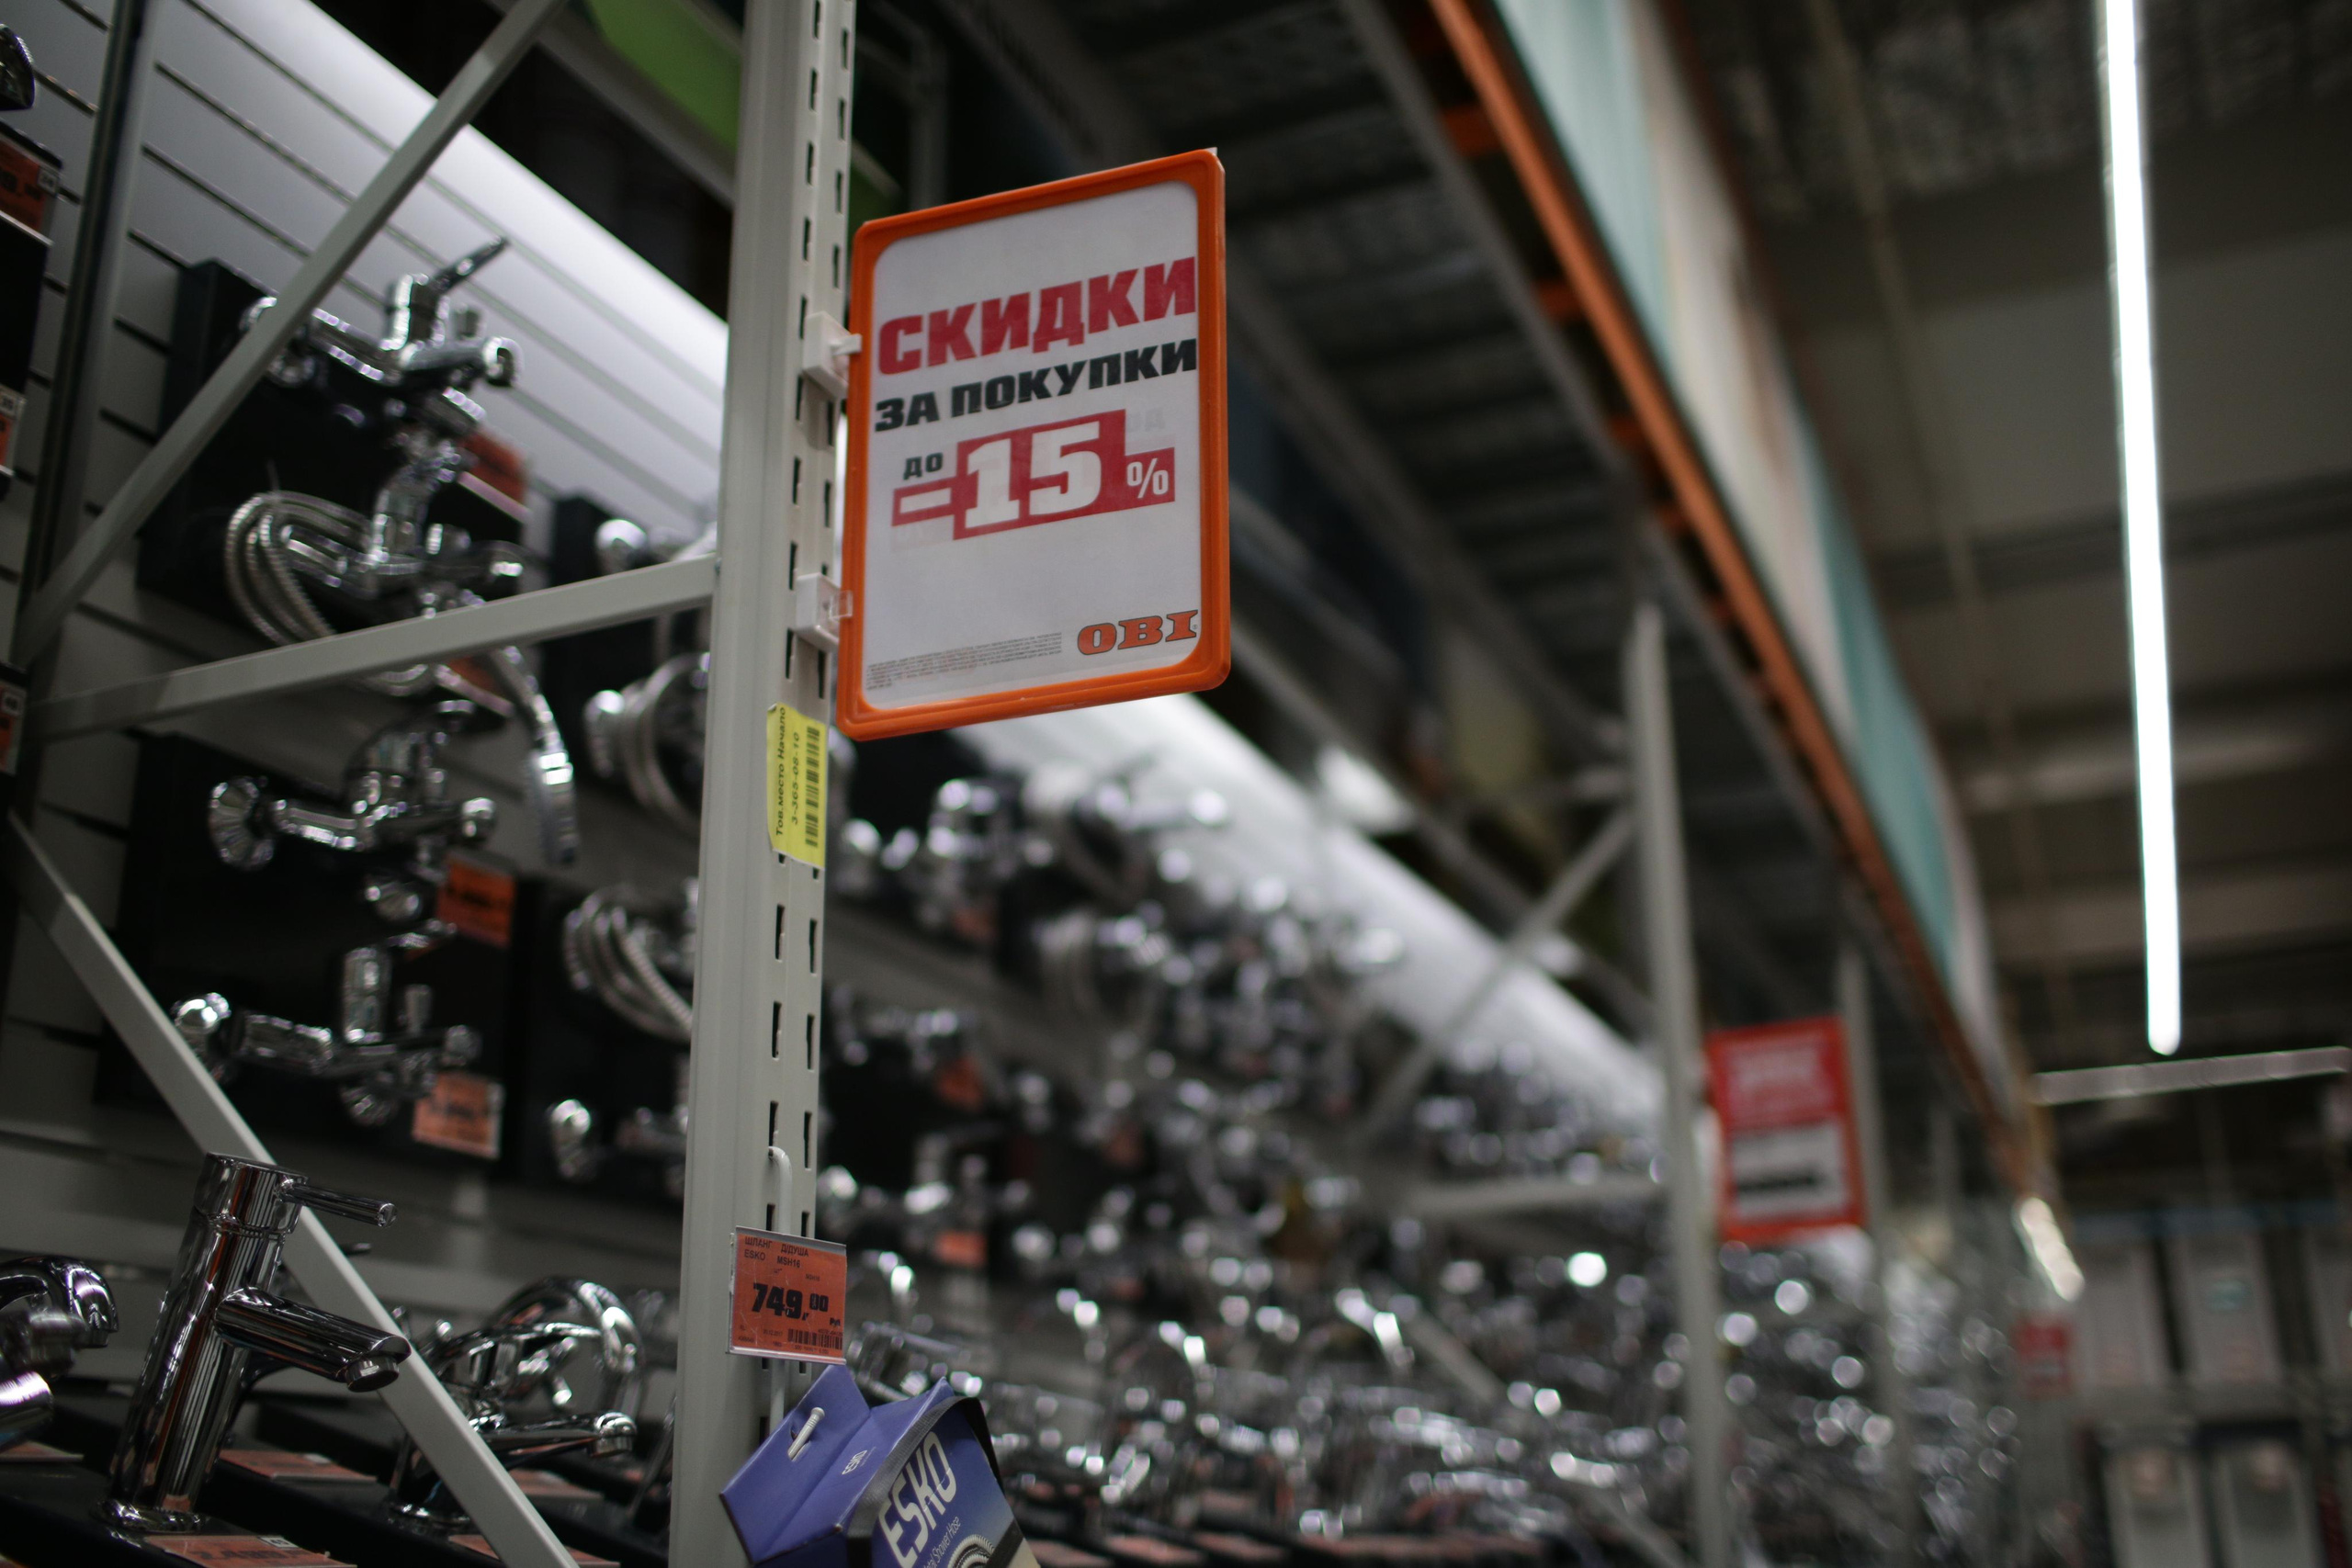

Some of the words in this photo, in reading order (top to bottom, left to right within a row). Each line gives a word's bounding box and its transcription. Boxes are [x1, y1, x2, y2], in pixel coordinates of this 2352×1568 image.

[878, 256, 1196, 376] СКИДКИ
[875, 392, 939, 433] ЗА
[952, 338, 1197, 418] ПОКУПКИ
[1077, 609, 1198, 655] OBI
[777, 707, 786, 760] Начало
[744, 1235, 773, 1248] ШЛАНГ
[744, 1249, 765, 1261] ESKO
[776, 1256, 800, 1268] MSH16
[878, 1431, 957, 1568] ESKO
[932, 1532, 951, 1563] Shower
[945, 1516, 961, 1539] Hose
